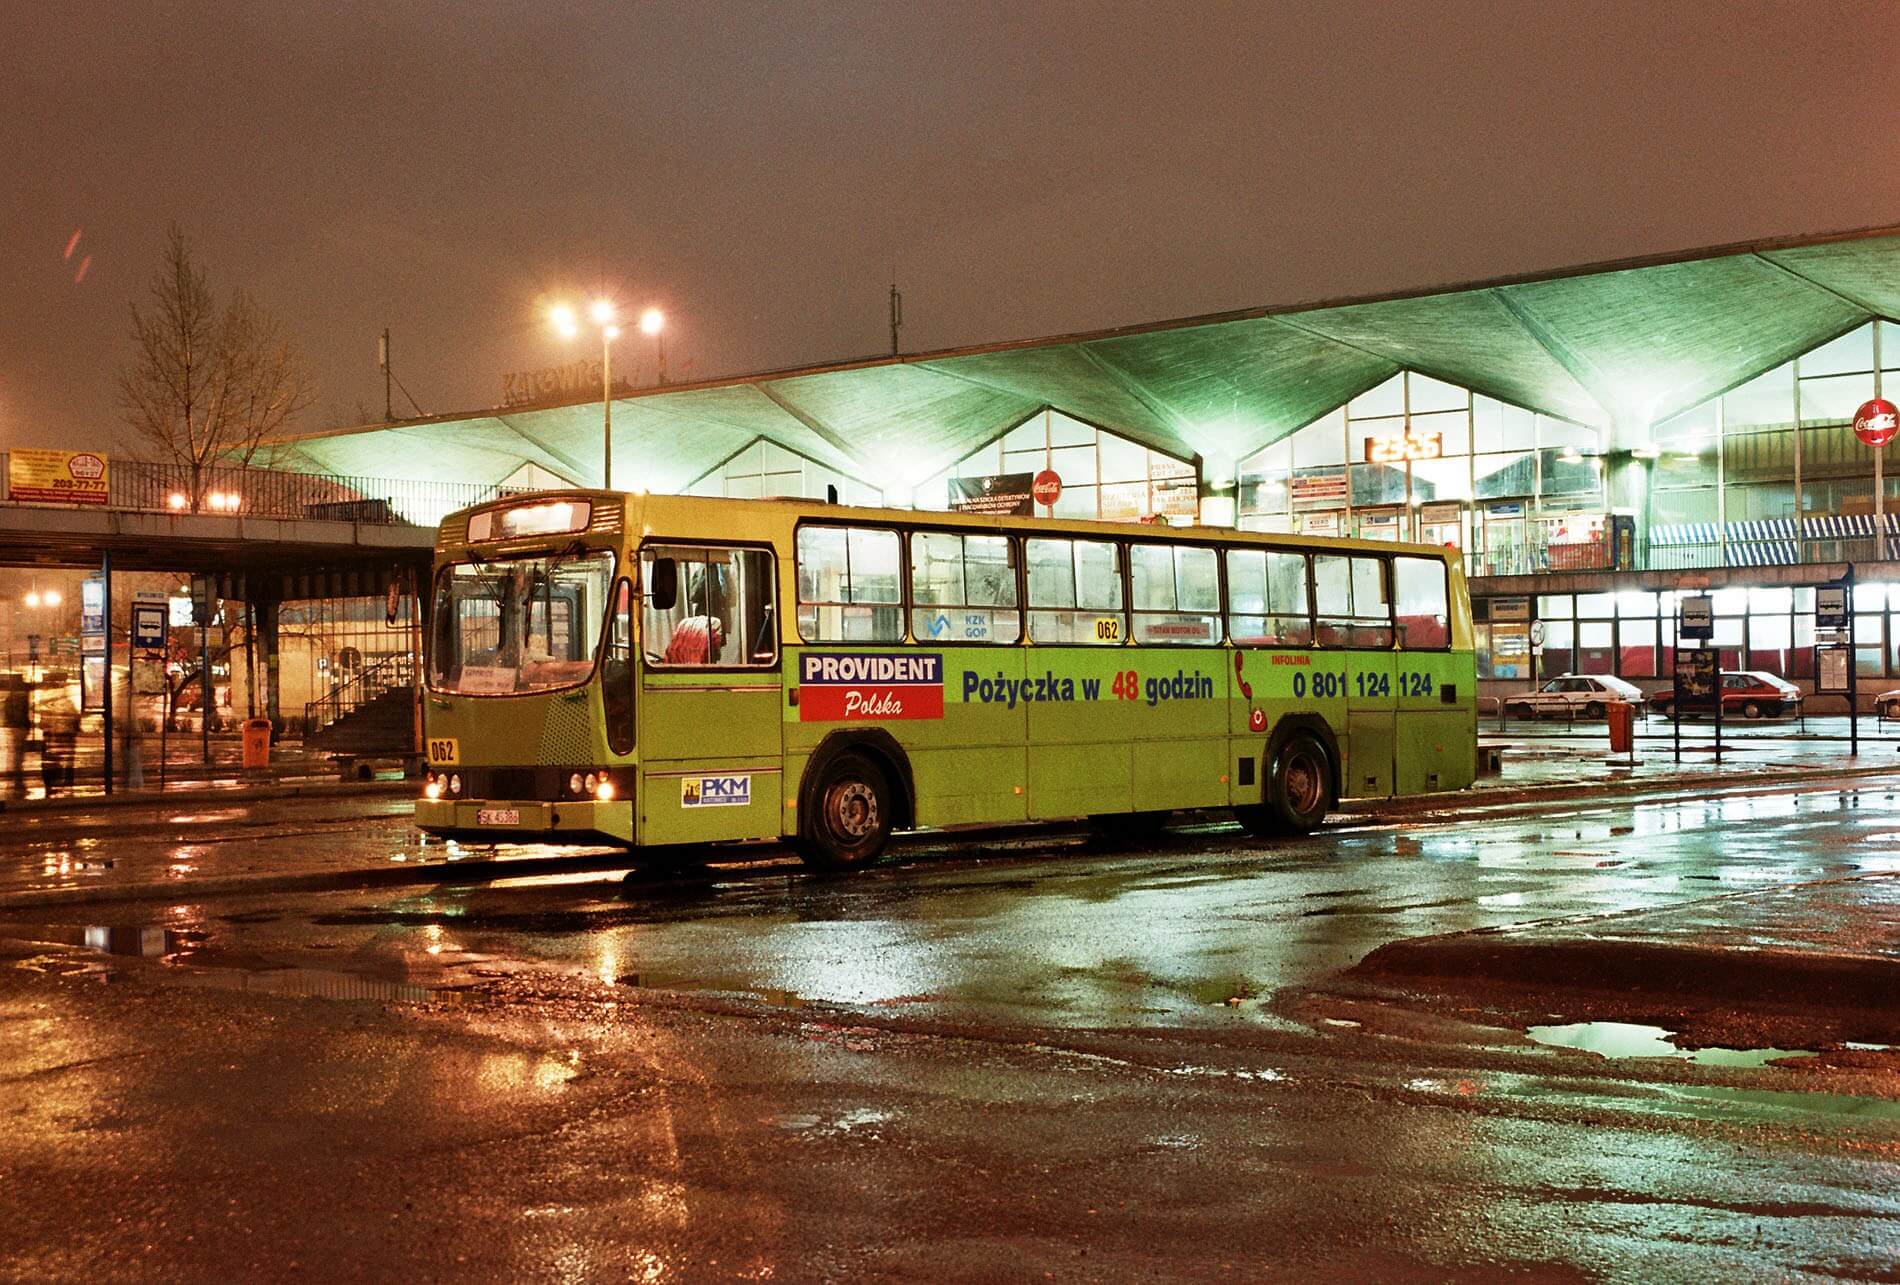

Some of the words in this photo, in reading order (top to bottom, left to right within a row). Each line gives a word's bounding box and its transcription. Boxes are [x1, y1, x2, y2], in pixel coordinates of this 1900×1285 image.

[52, 479, 105, 490] 203-77-77
[1033, 481, 1059, 494] Coca-Cola
[997, 501, 1020, 509] OCHRONY
[965, 615, 985, 625] KZK
[966, 628, 987, 638] GOP
[1097, 621, 1118, 639] 062
[806, 657, 936, 680] PROVIDENT
[1272, 655, 1311, 665] INFOLINIA
[963, 671, 1074, 709] Pożyczka
[1082, 679, 1101, 700] w
[1112, 671, 1139, 700] 48
[1146, 670, 1213, 706] godzin
[1293, 672, 1306, 698] 0
[1312, 672, 1346, 698] 801
[1356, 672, 1390, 697] 124
[1400, 672, 1432, 697] 124
[845, 691, 903, 717] Polska
[432, 741, 454, 761] 062
[702, 778, 748, 795] PKM
